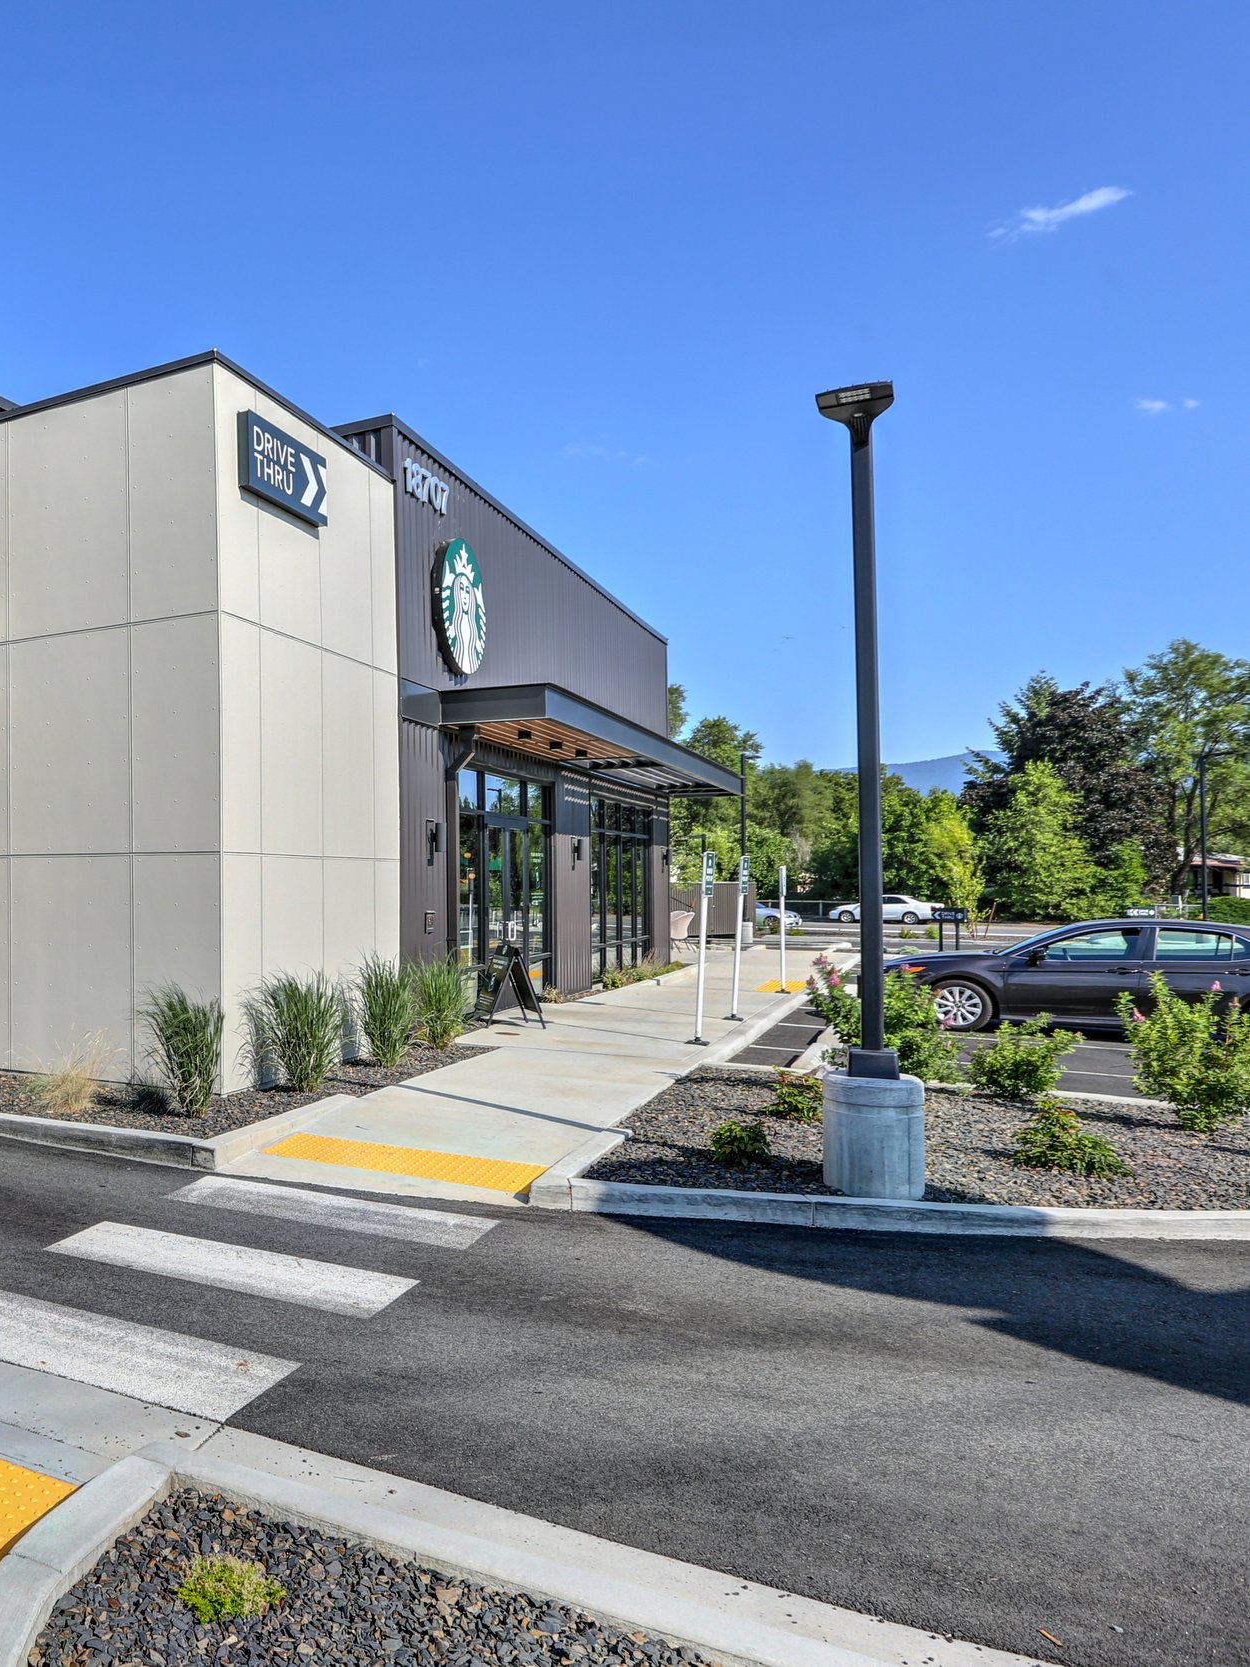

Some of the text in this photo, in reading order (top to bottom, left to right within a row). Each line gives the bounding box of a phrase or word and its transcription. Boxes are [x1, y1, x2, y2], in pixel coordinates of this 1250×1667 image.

[253, 425, 296, 473] DRIVE
[253, 451, 293, 495] THRU
[405, 457, 449, 515] 18707
